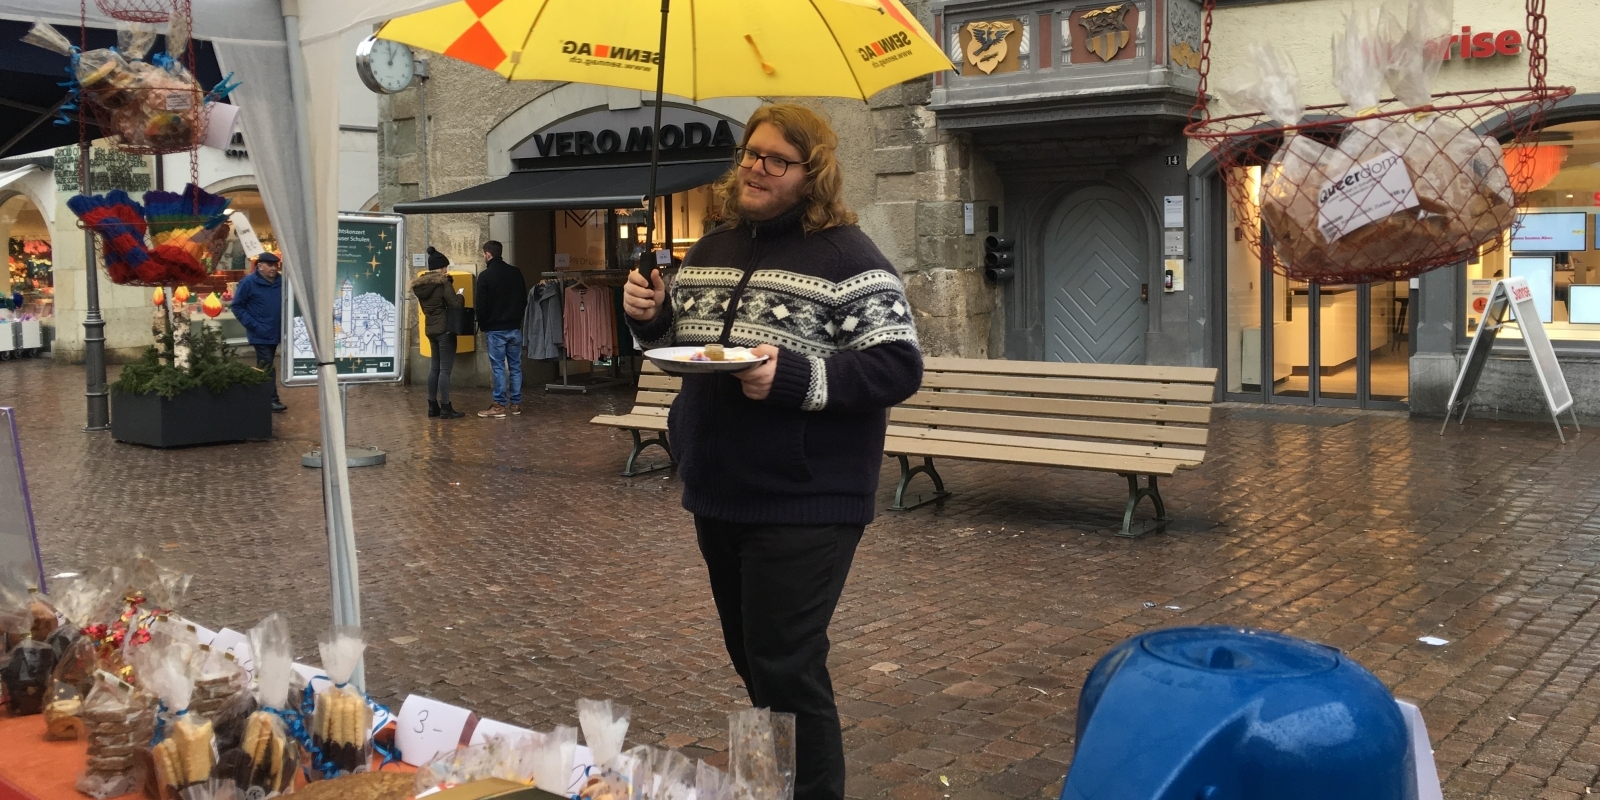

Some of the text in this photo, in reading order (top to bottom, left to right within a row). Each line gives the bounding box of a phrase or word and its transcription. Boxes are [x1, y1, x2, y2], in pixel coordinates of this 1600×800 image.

[533, 119, 736, 157] VERO MODA
[1167, 156, 1178, 165] 14
